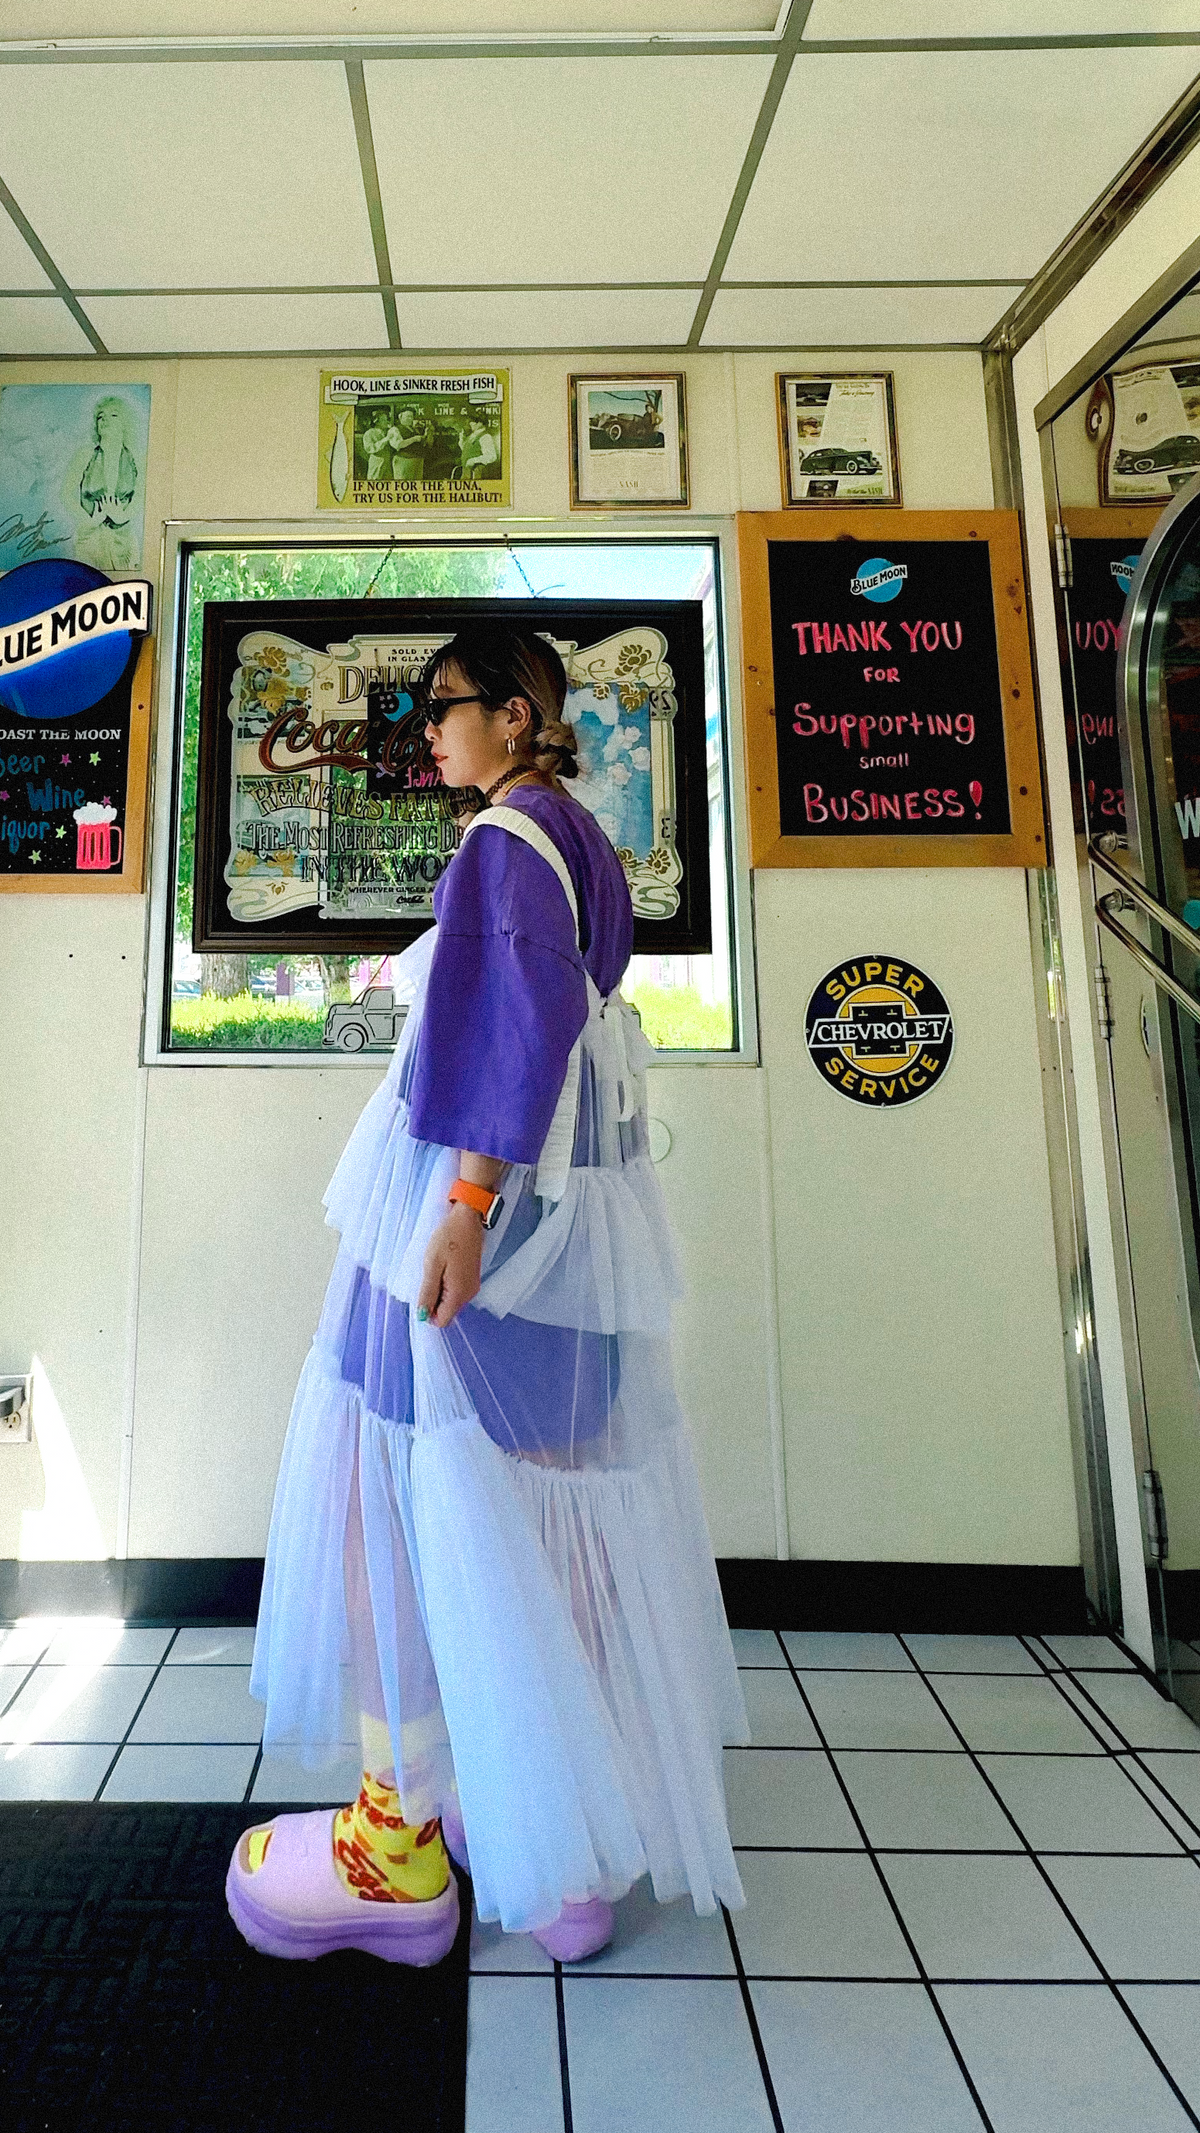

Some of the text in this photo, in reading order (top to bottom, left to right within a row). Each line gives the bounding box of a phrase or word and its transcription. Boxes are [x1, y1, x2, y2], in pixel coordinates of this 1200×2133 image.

[333, 376, 495, 393] HOOK, LINE & SINKER FRESH FISH
[353, 481, 364, 491] IF
[367, 481, 391, 491] NOT
[394, 481, 418, 491] FOR
[421, 481, 445, 491] THE
[353, 492, 503, 503] TRY US FOR THE HALIBUT!
[851, 566, 906, 594] BLUE MOON
[51, 590, 142, 647] MOON
[791, 619, 963, 656] THANK YOU
[337, 665, 424, 704] DELIC
[862, 666, 901, 683] FOR
[0, 729, 122, 740] OAST THE MOON
[859, 753, 910, 769] small
[26, 778, 86, 812] Wine
[249, 777, 384, 820] RELIEVES
[1, 815, 51, 854] iquor
[246, 822, 281, 850] THE
[283, 821, 329, 853] MOST
[331, 821, 438, 855] REFRESHING
[300, 854, 329, 883] IN
[331, 853, 388, 883] THE
[825, 961, 925, 1001] SUPER
[816, 1020, 944, 1043] CHEVROLET
[824, 1053, 940, 1098] SERVICE
